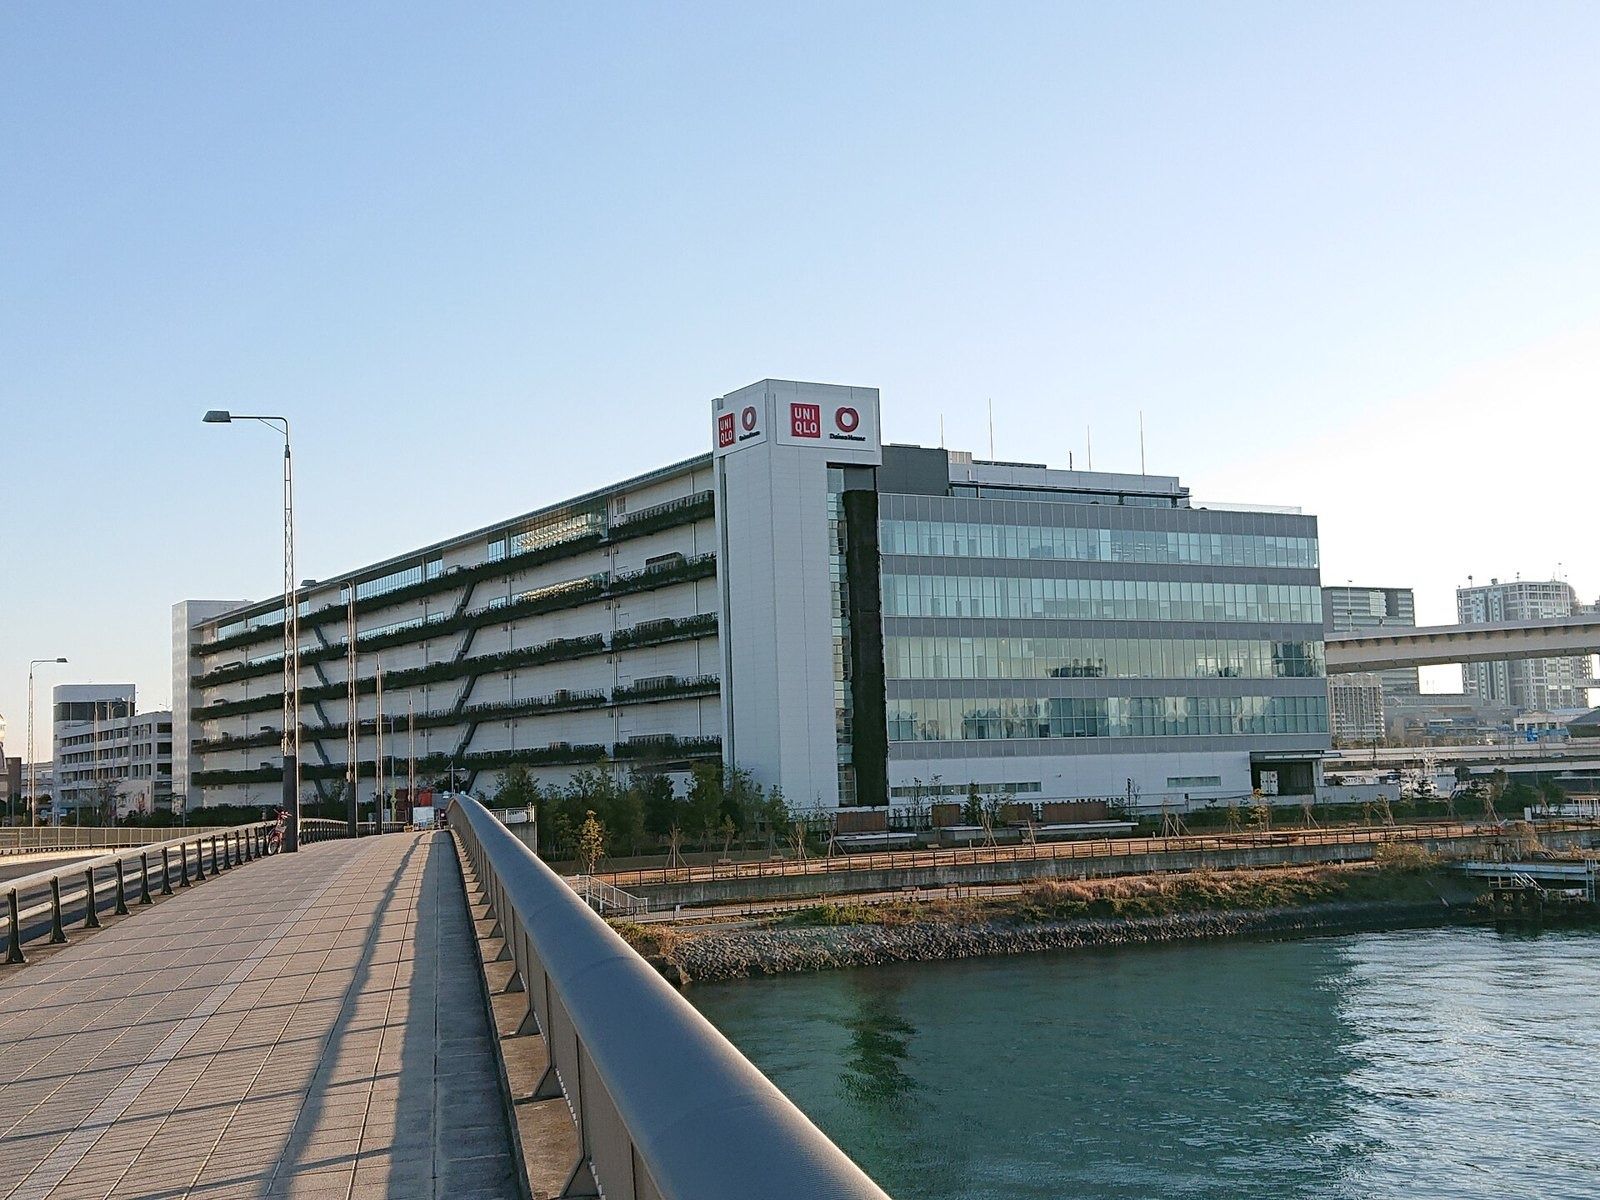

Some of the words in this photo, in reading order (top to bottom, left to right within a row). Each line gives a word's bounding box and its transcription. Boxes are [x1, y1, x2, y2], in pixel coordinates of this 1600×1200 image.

[795, 407, 815, 420] UNI
[720, 417, 732, 431] UNI
[795, 421, 817, 435] QLO
[720, 430, 732, 444] QLO
